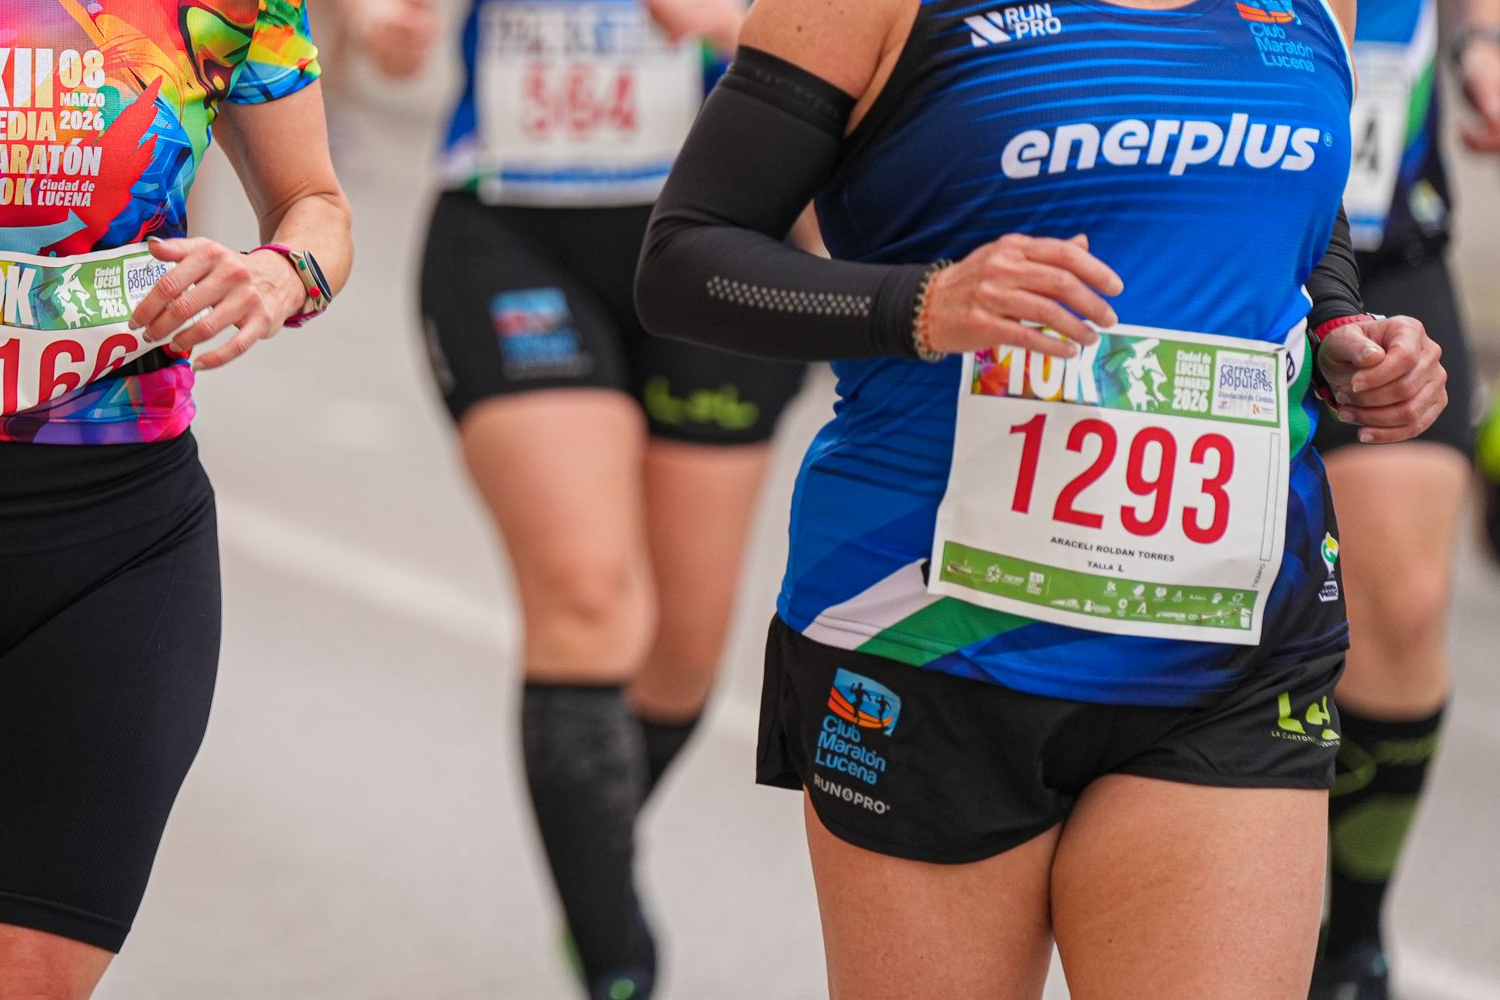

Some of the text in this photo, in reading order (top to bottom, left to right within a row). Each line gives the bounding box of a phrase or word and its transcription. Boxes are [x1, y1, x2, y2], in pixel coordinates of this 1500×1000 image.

[1004, 3, 1052, 30] RUN
[1015, 17, 1062, 40] PRO
[1249, 21, 1286, 40] Club
[59, 49, 105, 89] 08
[1261, 51, 1316, 73] Lucena
[60, 92, 105, 107] MARZO
[60, 110, 105, 131] 2026
[1000, 112, 1320, 179] enerplus
[40, 179, 95, 192] Ciudad de
[37, 192, 92, 207] LUCENA
[128, 275, 163, 293] popula
[99, 298, 129, 319] 2026
[997, 332, 1101, 403] 10K
[1175, 360, 1210, 379] LUCENA
[1220, 363, 1267, 381] carreras
[1220, 372, 1273, 393] populares
[1172, 387, 1209, 413] 2026
[1008, 413, 1236, 545] 1293
[1050, 536, 1175, 562] ARACELI ROLDAN TORRES
[1087, 561, 1125, 573] TALLA L
[823, 714, 861, 743] Club
[818, 731, 886, 772] Maratón
[815, 748, 877, 785] Lucena
